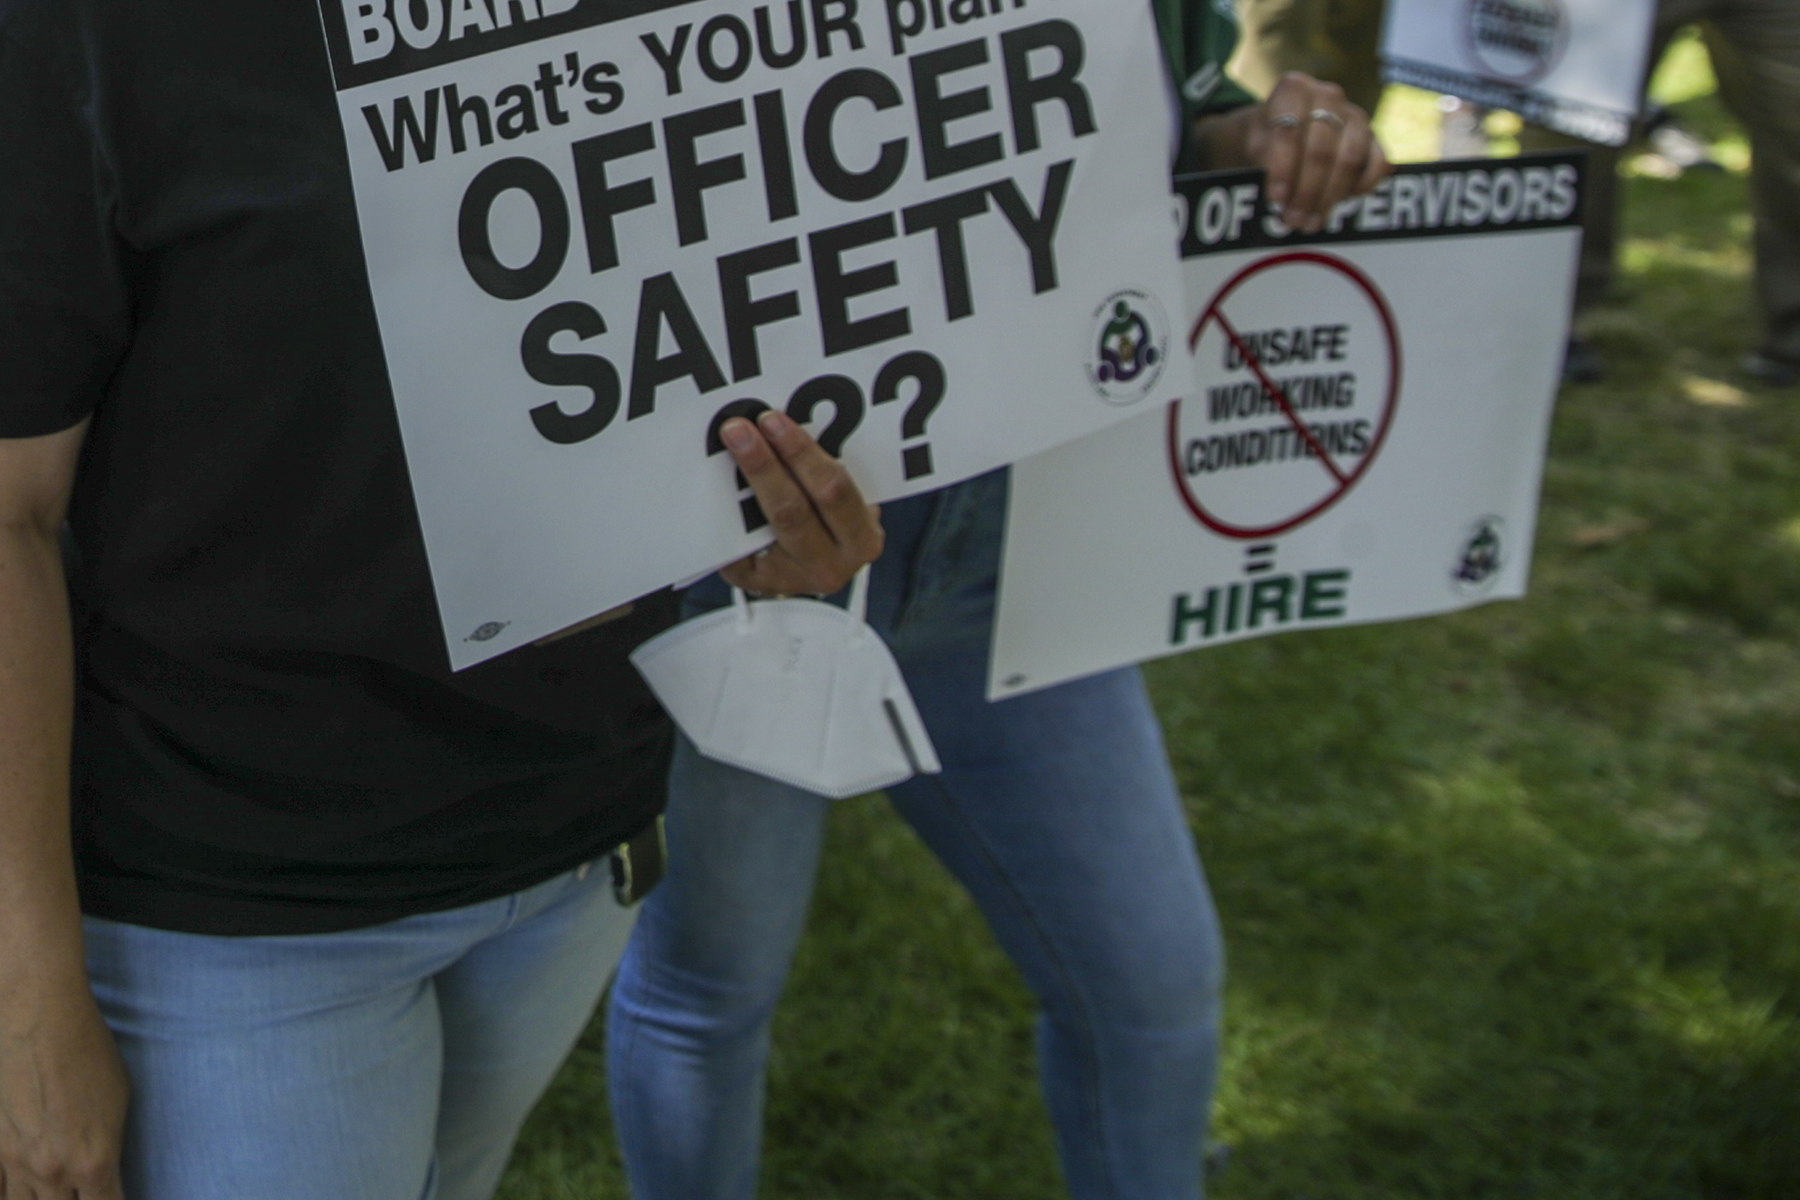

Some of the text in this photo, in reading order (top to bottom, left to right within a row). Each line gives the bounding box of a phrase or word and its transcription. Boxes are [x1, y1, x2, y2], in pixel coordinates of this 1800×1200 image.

[362, 52, 625, 173] What's
[457, 17, 1098, 301] OFFICER
[1196, 183, 1260, 245] OF
[520, 158, 1077, 445] SAFETY
[1223, 324, 1350, 371] UNSAFE
[1207, 372, 1356, 423] WORKING
[1185, 418, 1371, 477] CONDITIONS
[1170, 568, 1351, 645] HIRE
